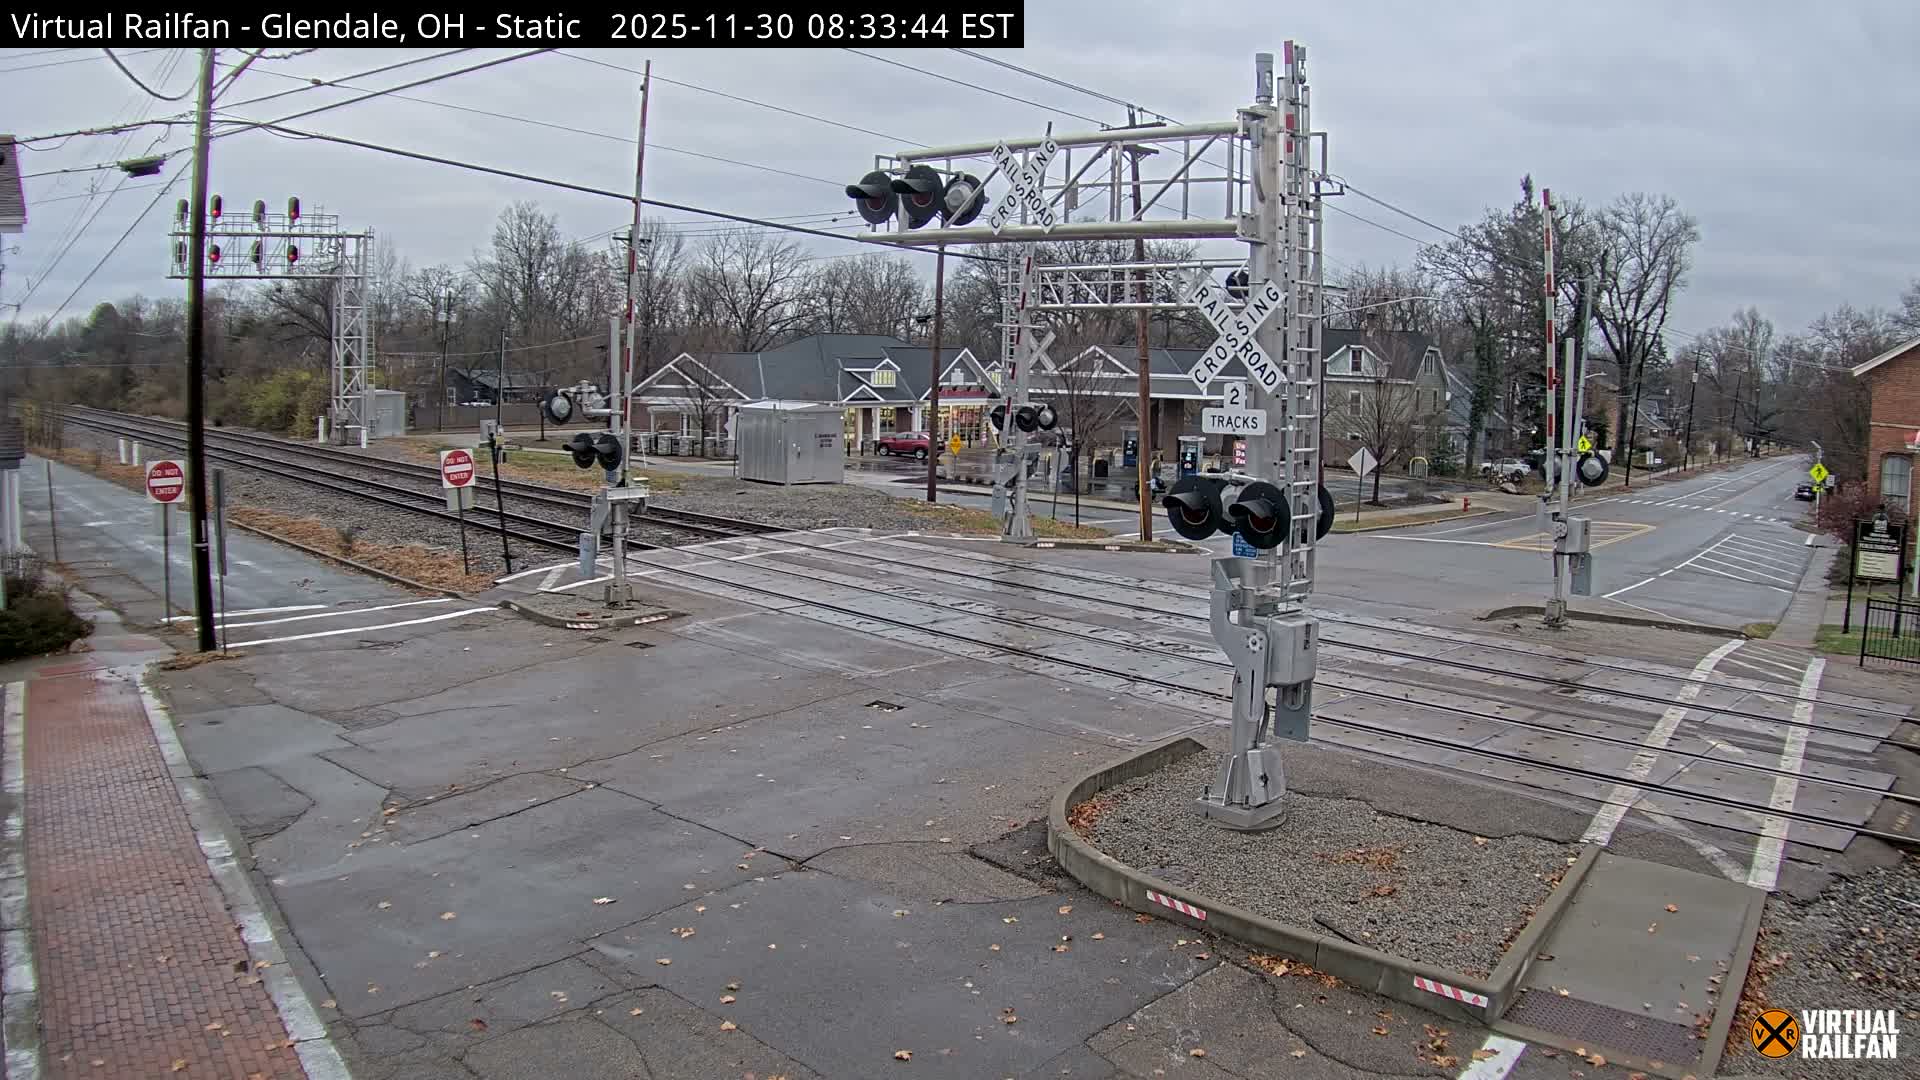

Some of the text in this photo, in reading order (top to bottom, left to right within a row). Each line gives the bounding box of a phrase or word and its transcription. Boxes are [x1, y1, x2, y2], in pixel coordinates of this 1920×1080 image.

[990, 141, 1055, 229] CROSSING
[1194, 286, 1279, 384] CROSSING
[1230, 388, 1239, 405] 2
[1211, 415, 1258, 429] TRACKS
[152, 469, 162, 477] DO
[450, 472, 468, 481] ENTER
[155, 486, 176, 494] ENTER
